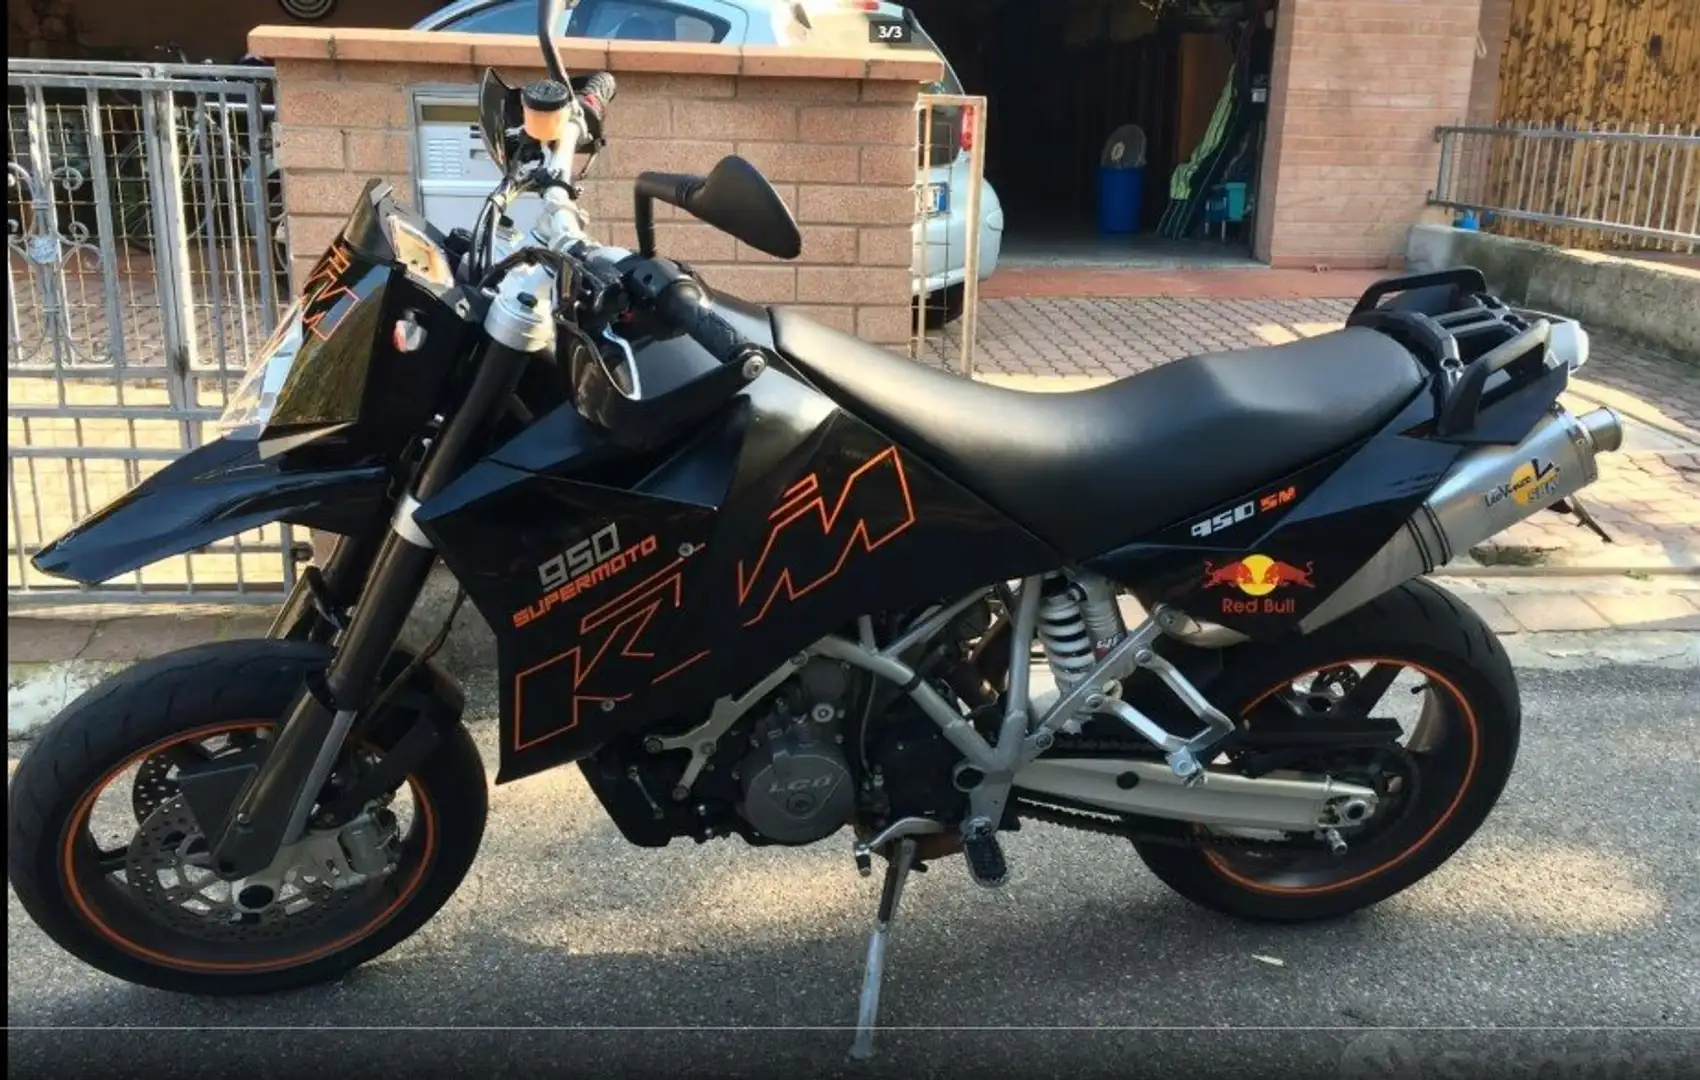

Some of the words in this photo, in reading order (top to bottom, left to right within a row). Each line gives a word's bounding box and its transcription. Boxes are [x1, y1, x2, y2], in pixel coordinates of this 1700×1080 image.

[1190, 500, 1255, 537] 950
[1259, 486, 1297, 512] SM
[512, 533, 659, 628] SUPERMOTO
[537, 522, 621, 593] 950
[1222, 598, 1259, 613] Red
[1263, 598, 1296, 613] Bull
